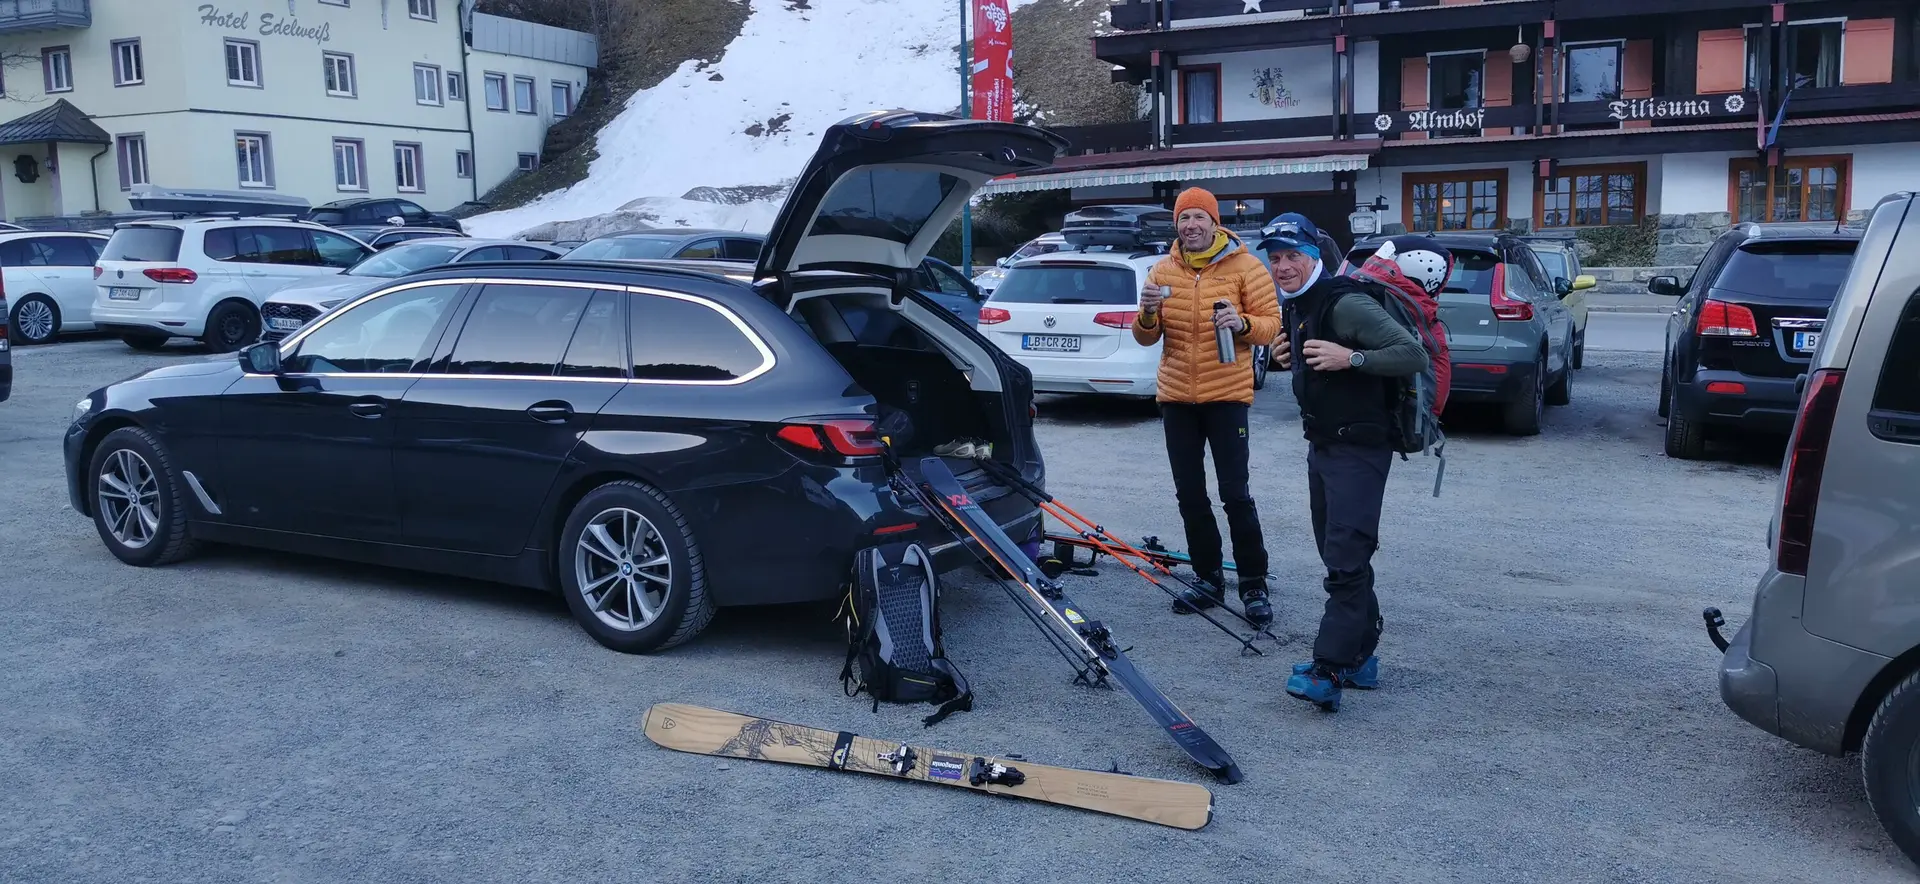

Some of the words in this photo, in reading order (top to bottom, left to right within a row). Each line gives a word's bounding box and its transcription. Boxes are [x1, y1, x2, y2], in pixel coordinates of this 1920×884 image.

[198, 4, 248, 30] Hotel
[259, 13, 330, 45] Edelweiß
[994, 20, 1006, 33] 27
[1409, 108, 1485, 130] Almhof
[1608, 97, 1711, 121] Tilisuna
[1028, 336, 1040, 347] LB
[1046, 337, 1059, 347] CR
[1061, 338, 1079, 349] 281
